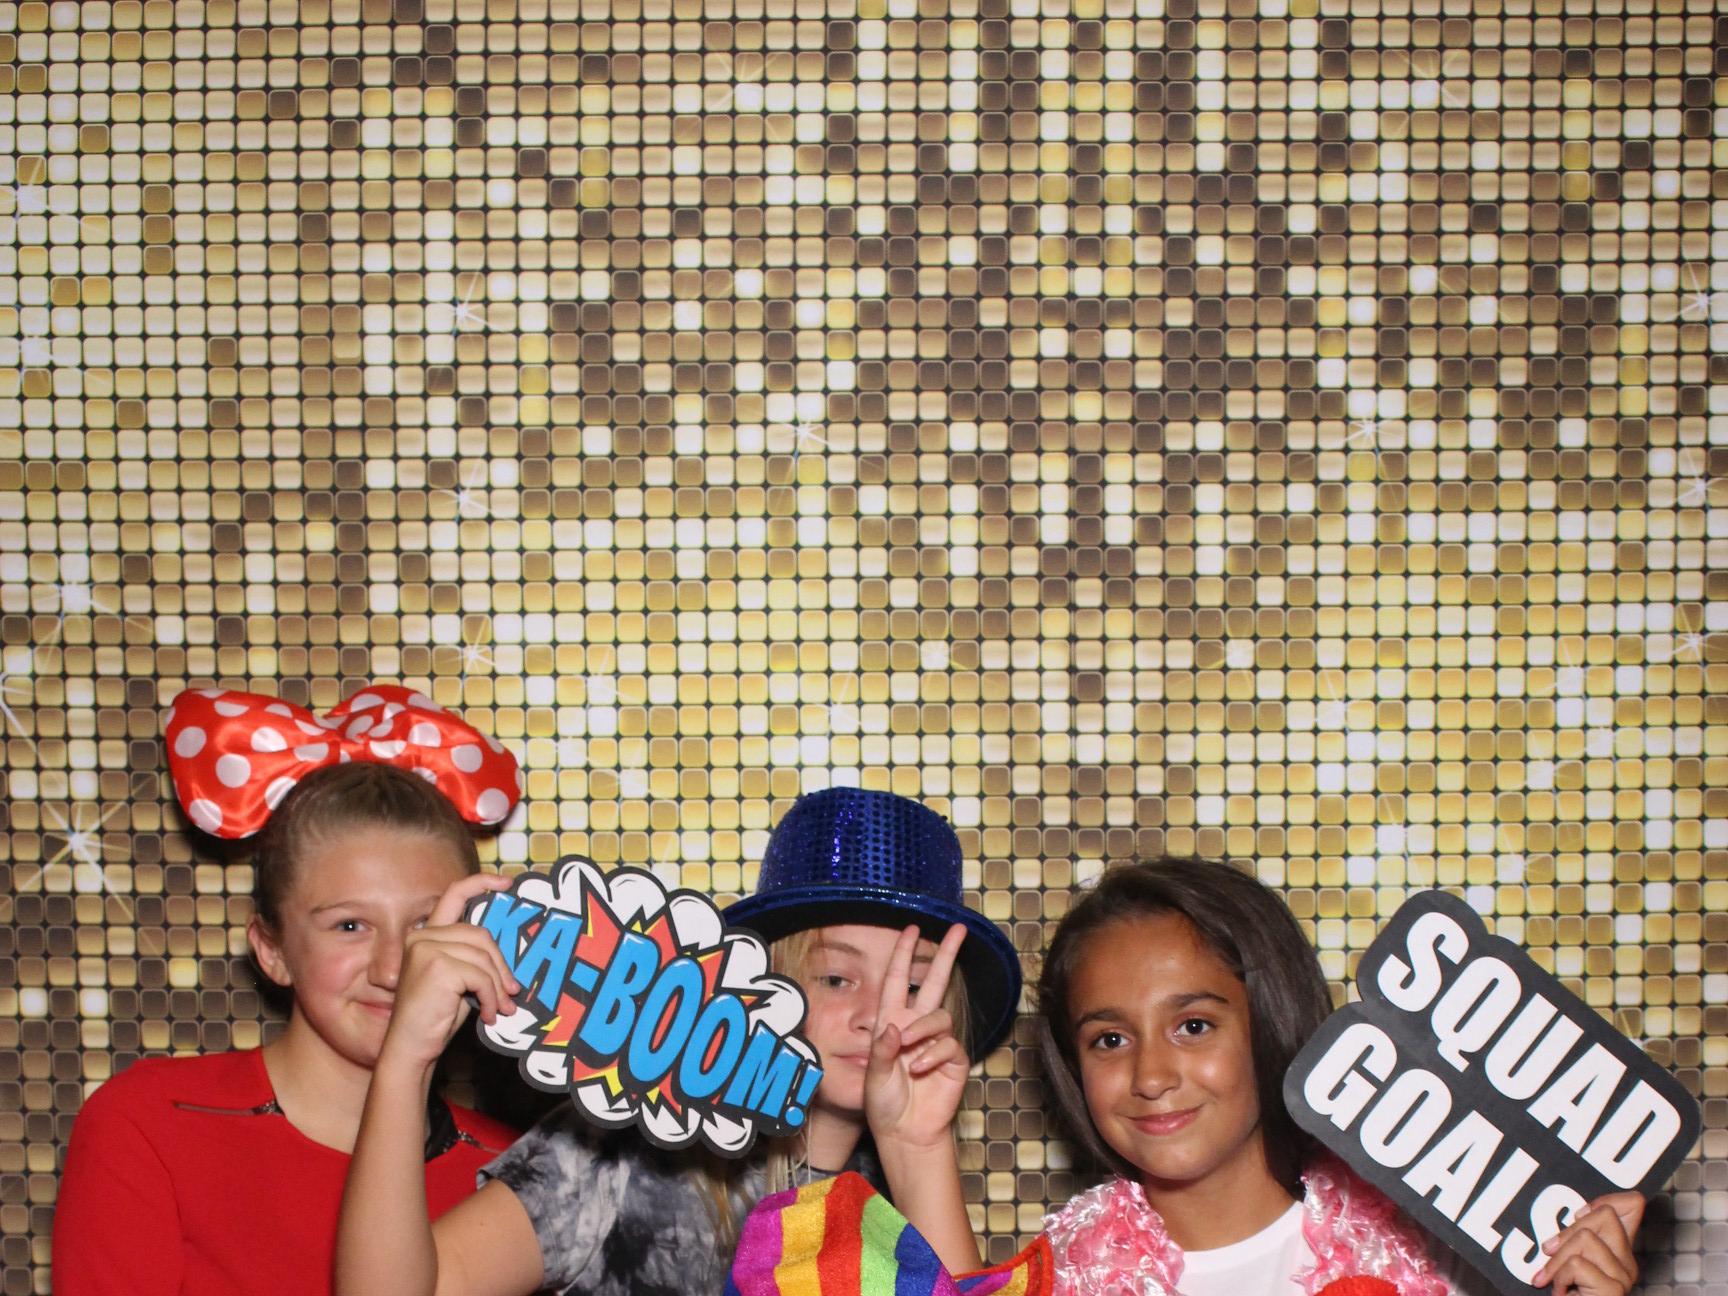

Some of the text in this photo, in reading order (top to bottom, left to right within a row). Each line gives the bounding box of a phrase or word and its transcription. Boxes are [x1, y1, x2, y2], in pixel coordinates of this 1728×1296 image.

[479, 892, 824, 1127] KA-BOOM!
[1377, 912, 1681, 1189] SQUAD
[1304, 1023, 1588, 1286] GOALS
